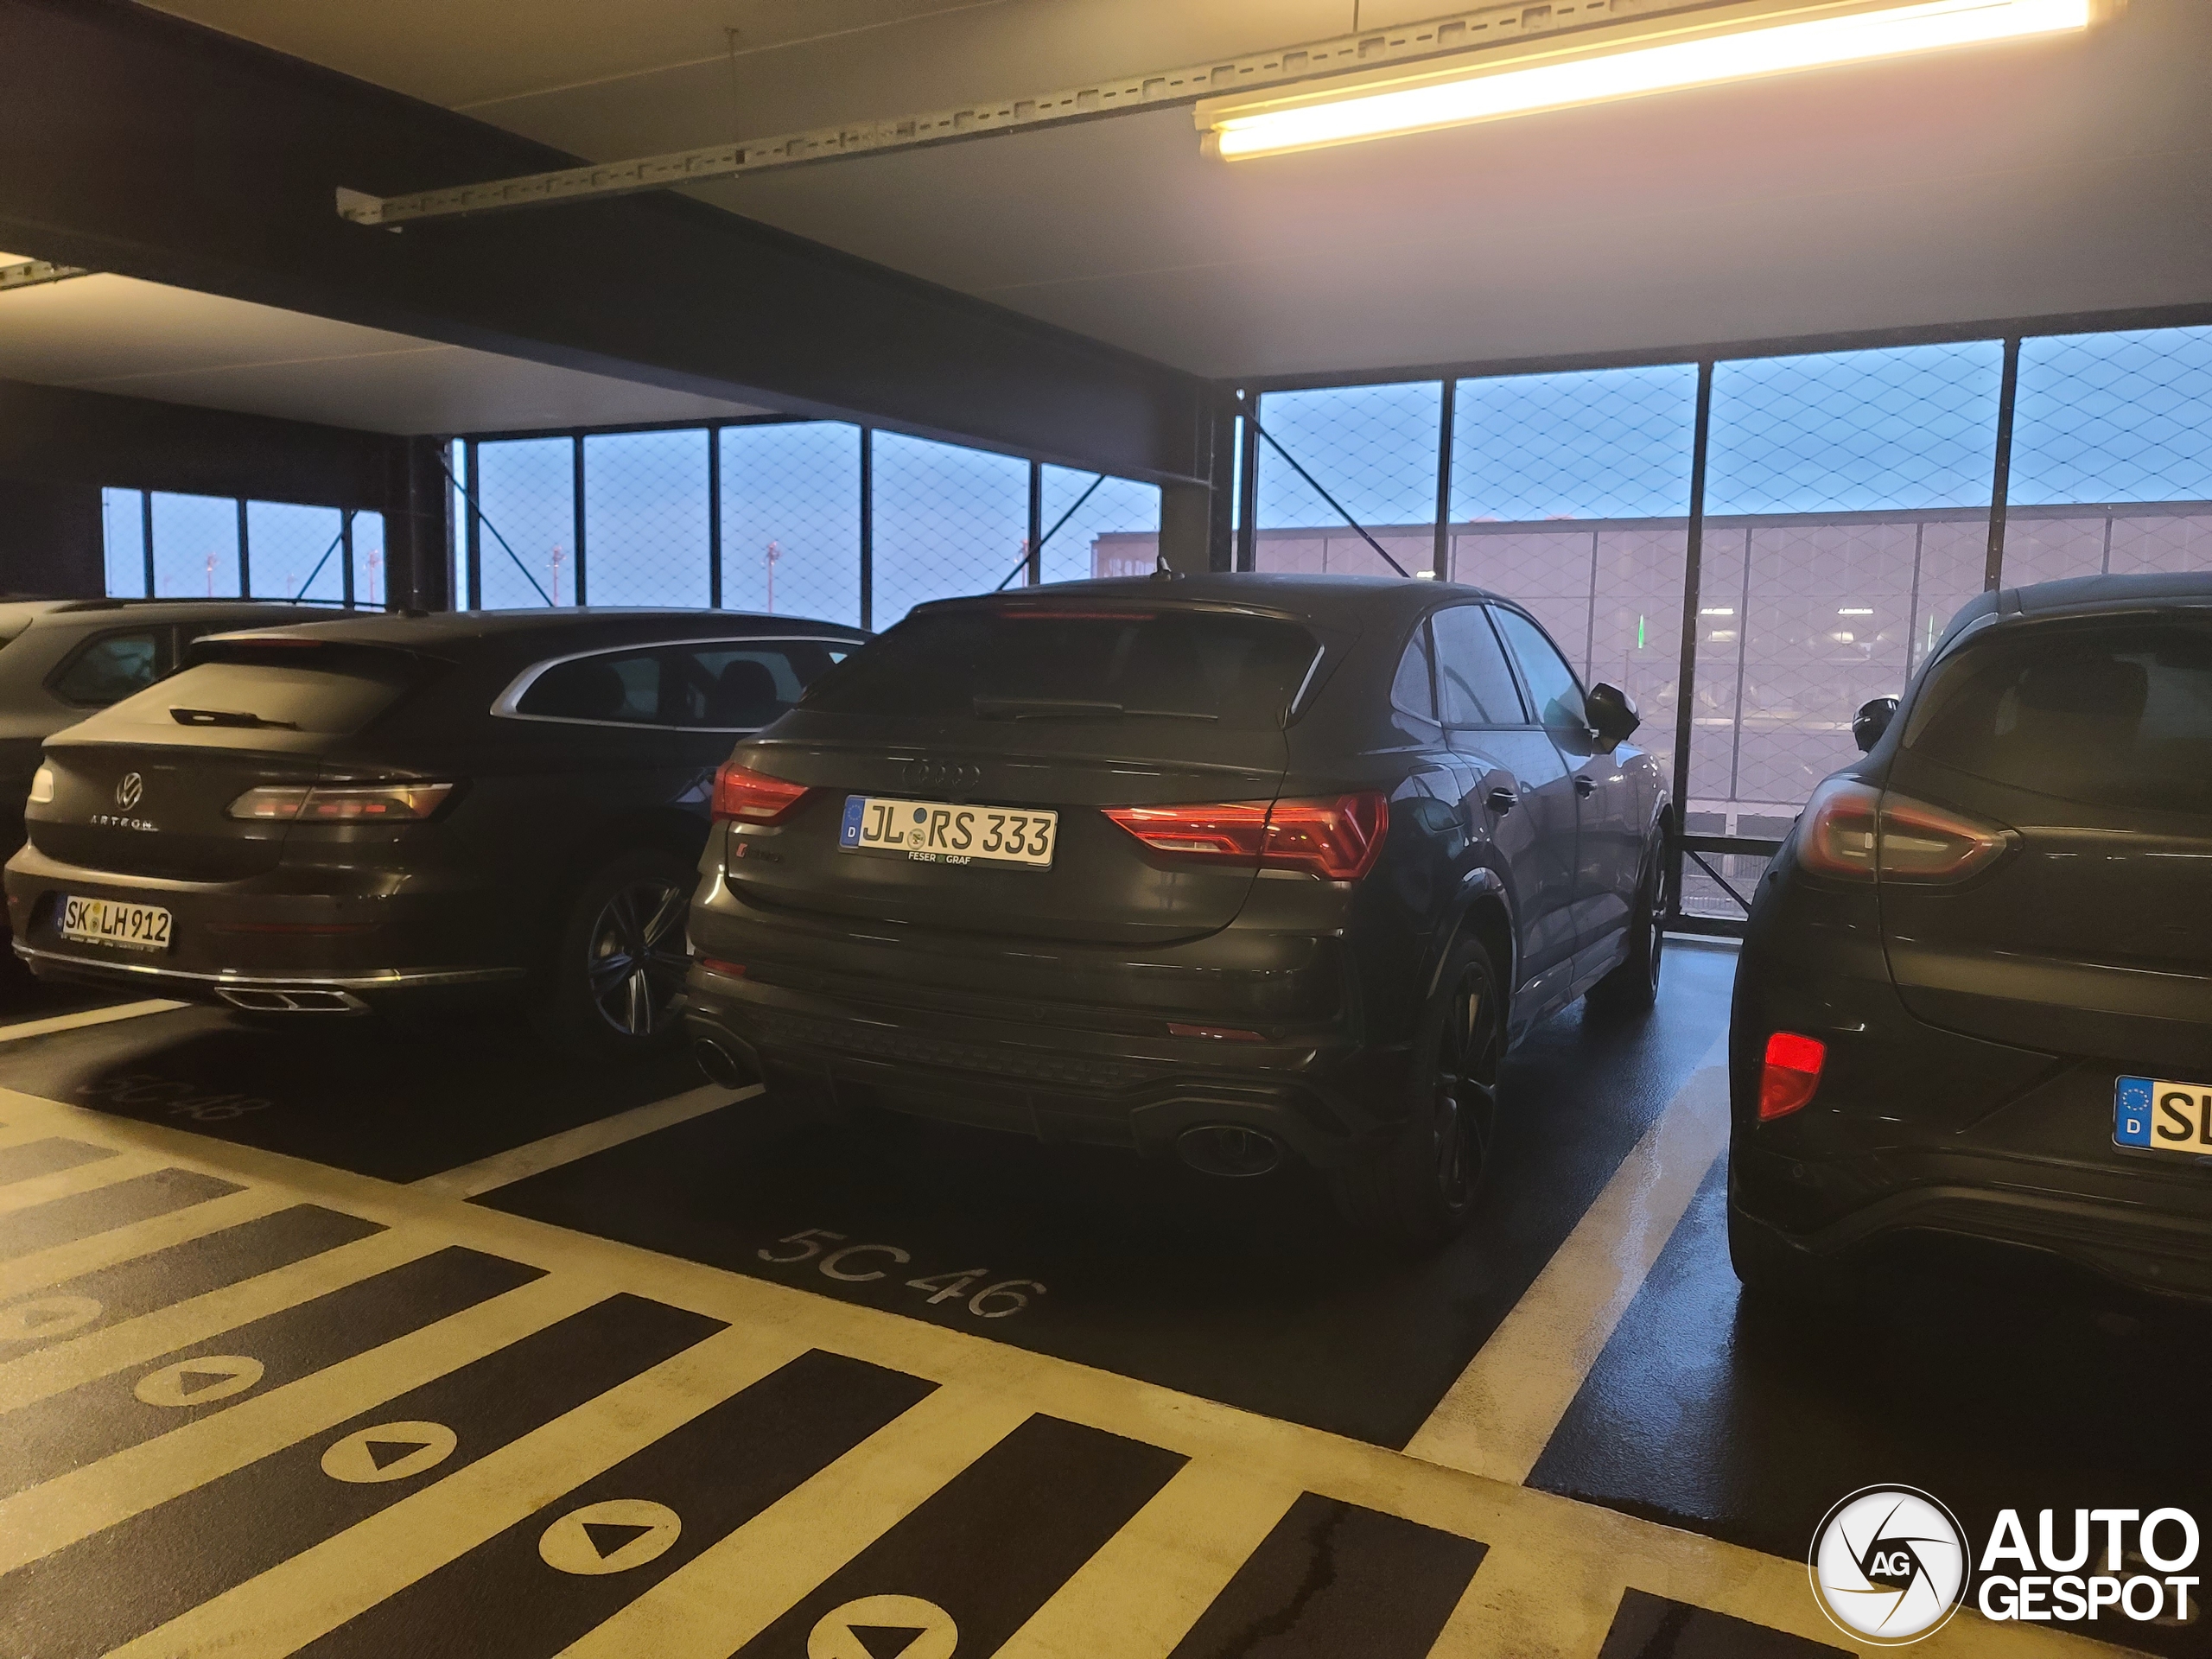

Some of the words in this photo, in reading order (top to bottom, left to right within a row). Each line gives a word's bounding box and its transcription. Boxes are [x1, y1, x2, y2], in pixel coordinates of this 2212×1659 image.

[847, 827, 855, 838] D
[863, 805, 904, 843] JL
[928, 810, 975, 849] RS
[982, 815, 1051, 855] 333
[908, 851, 936, 862] FESER
[946, 855, 971, 865] GRAF
[66, 900, 91, 930] SK
[101, 906, 128, 936] LH
[131, 910, 168, 942] 912
[2126, 1118, 2141, 1134] D
[758, 1229, 911, 1281] 5C
[906, 1268, 1047, 1318] 46
